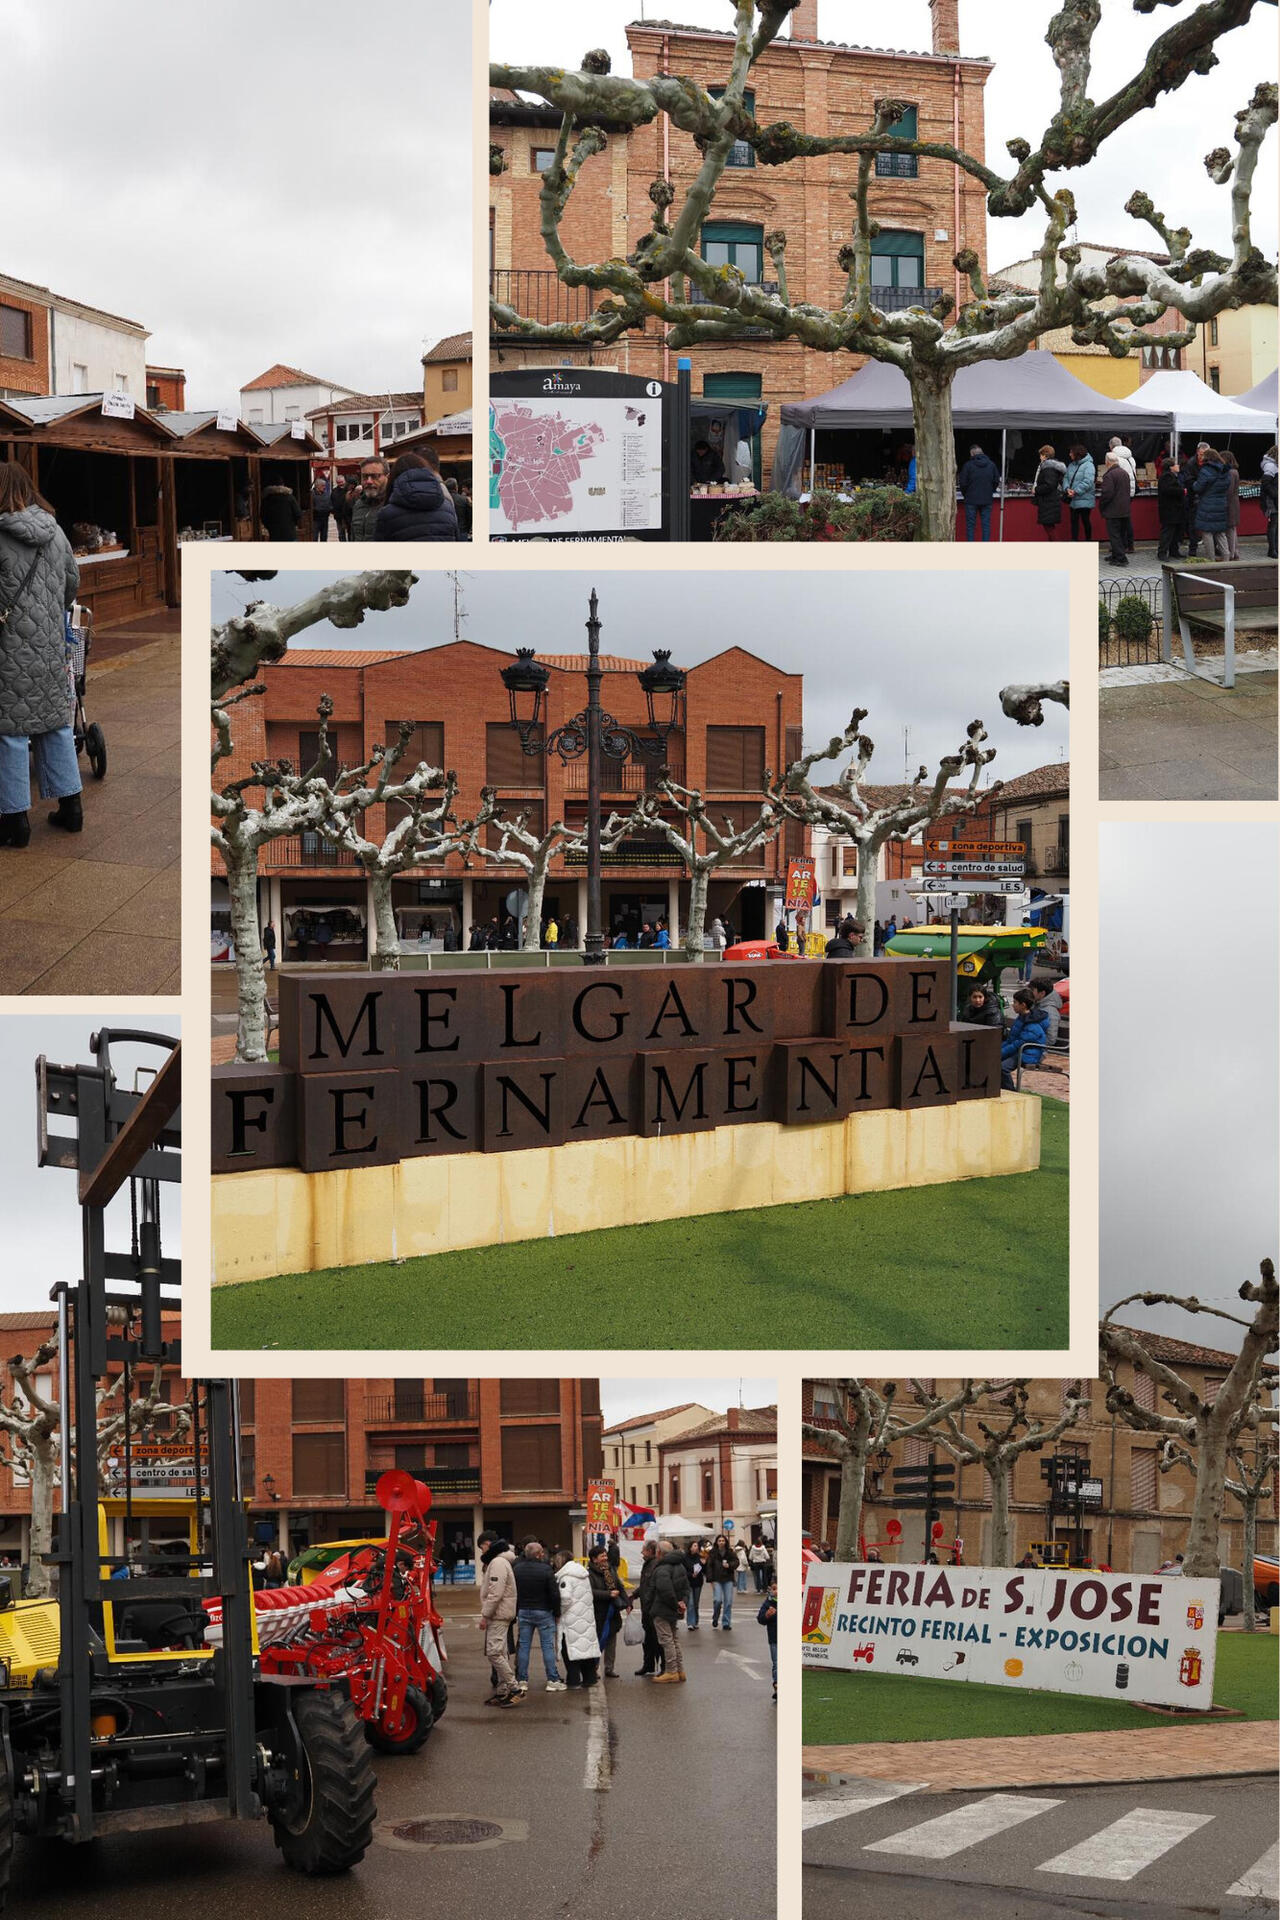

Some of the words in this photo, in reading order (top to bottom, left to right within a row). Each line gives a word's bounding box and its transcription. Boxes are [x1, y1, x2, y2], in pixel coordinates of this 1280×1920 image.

[542, 377, 581, 391] amaya
[976, 842, 1023, 852] deportiva
[951, 863, 982, 872] centro
[984, 863, 996, 872] de
[998, 863, 1023, 872] salud
[791, 870, 812, 880] AR
[793, 879, 809, 889] TE
[791, 889, 807, 897] SA
[308, 977, 763, 1060] MELGAR
[846, 971, 938, 1028] DE
[225, 1038, 989, 1159] FERNAMENTAL
[161, 1446, 208, 1455] deportva
[136, 1468, 166, 1477] centro
[168, 1468, 180, 1477] de
[182, 1468, 207, 1477] sald
[591, 1492, 612, 1502] AR
[593, 1501, 609, 1511] TE
[592, 1511, 608, 1520] SA
[847, 1569, 955, 1608] FERIA
[961, 1588, 991, 1609] DE
[1004, 1576, 1034, 1615] S.
[1047, 1579, 1162, 1625] JOSE
[837, 1614, 916, 1637] RECINTO
[921, 1620, 991, 1644] FERIAL
[1015, 1626, 1169, 1660] EXPOSICION
